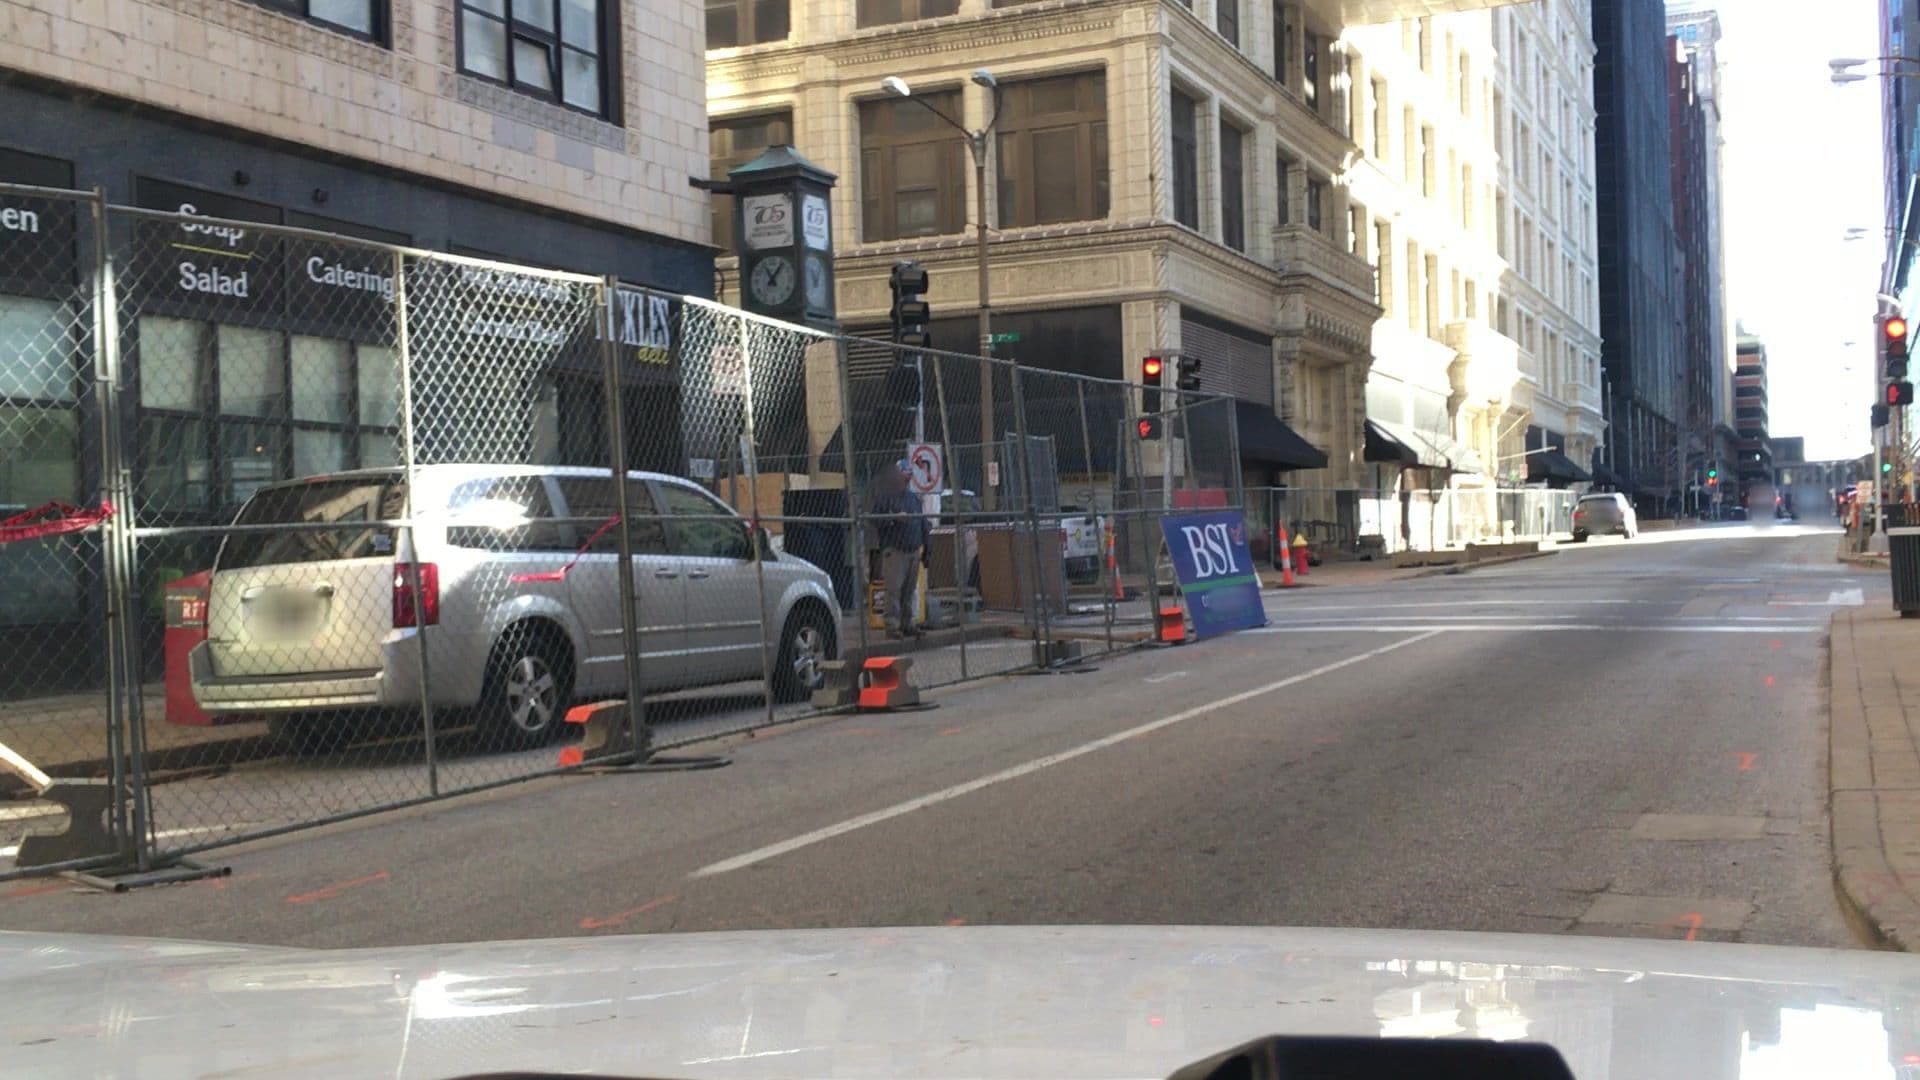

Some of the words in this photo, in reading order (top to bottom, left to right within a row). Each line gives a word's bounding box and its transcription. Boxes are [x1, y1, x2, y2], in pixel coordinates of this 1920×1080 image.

[0, 207, 38, 233] en
[179, 261, 249, 298] Salad
[306, 256, 394, 303] Catering
[1181, 523, 1239, 578] BSI
